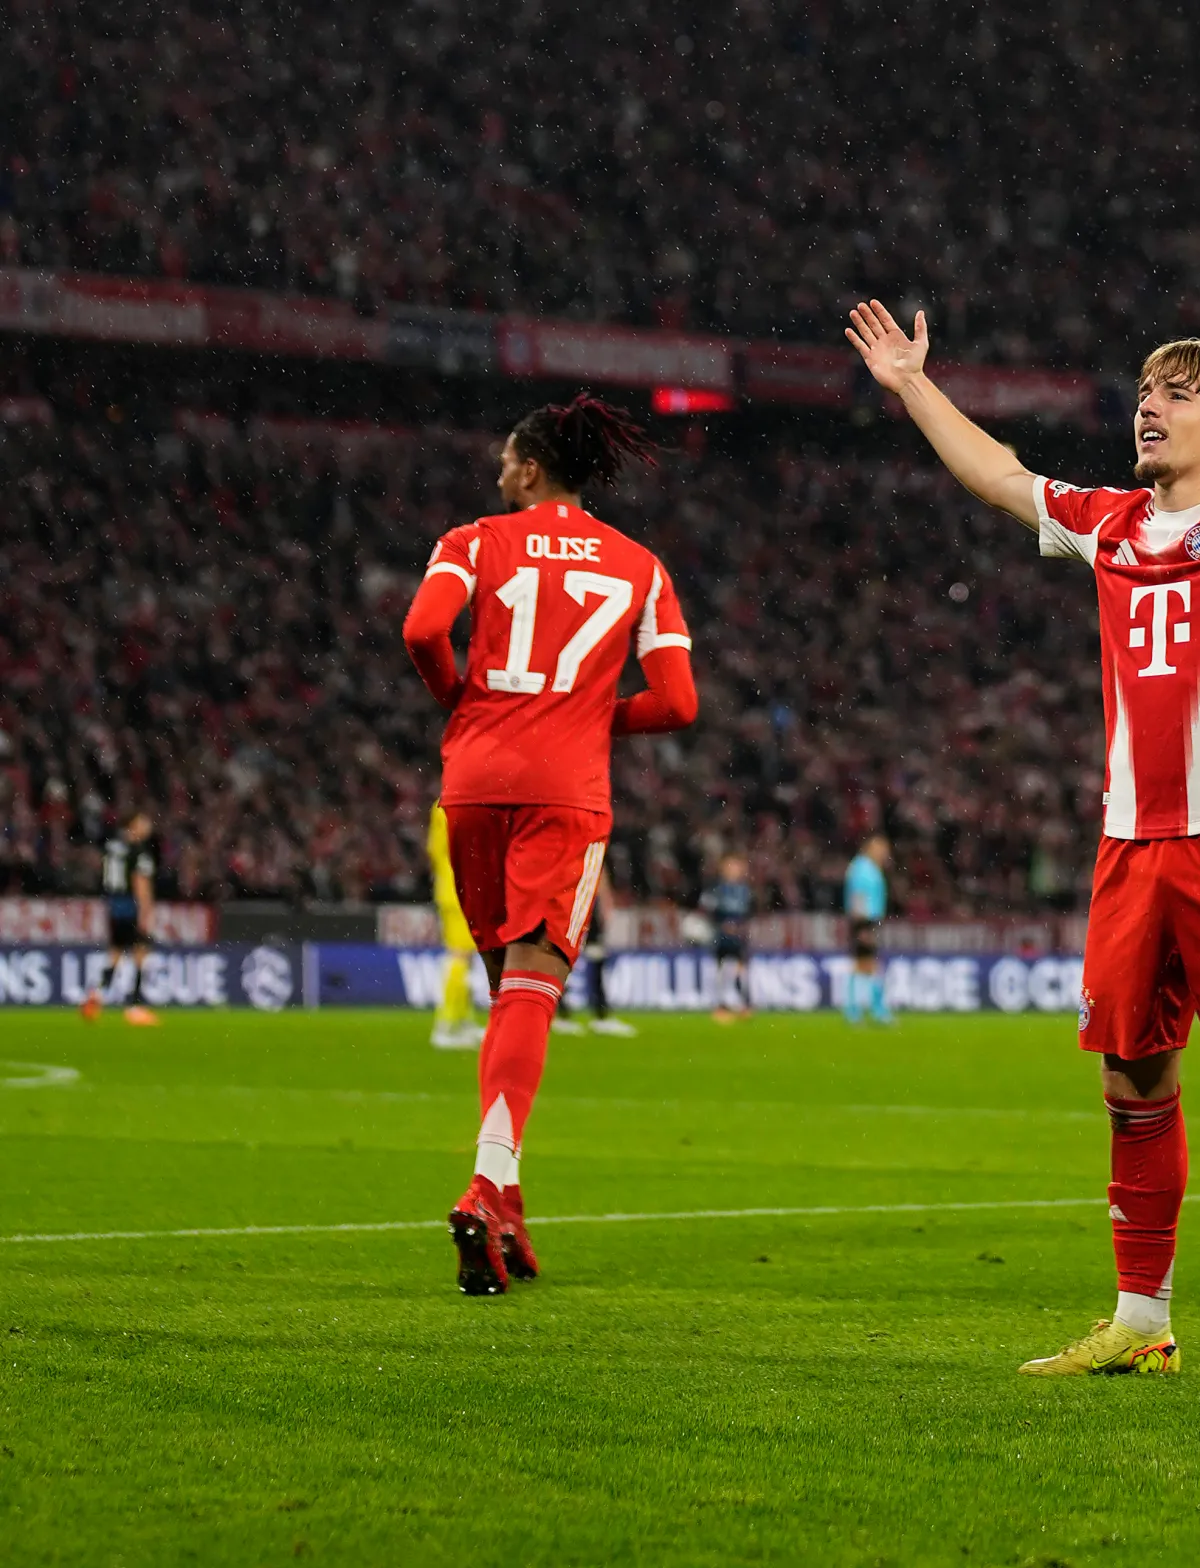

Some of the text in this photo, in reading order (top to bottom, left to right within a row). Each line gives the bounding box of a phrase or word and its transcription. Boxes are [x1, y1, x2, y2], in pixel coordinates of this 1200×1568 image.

[526, 533, 602, 563] OLISE
[487, 566, 634, 695] 17
[1128, 580, 1192, 678] T
